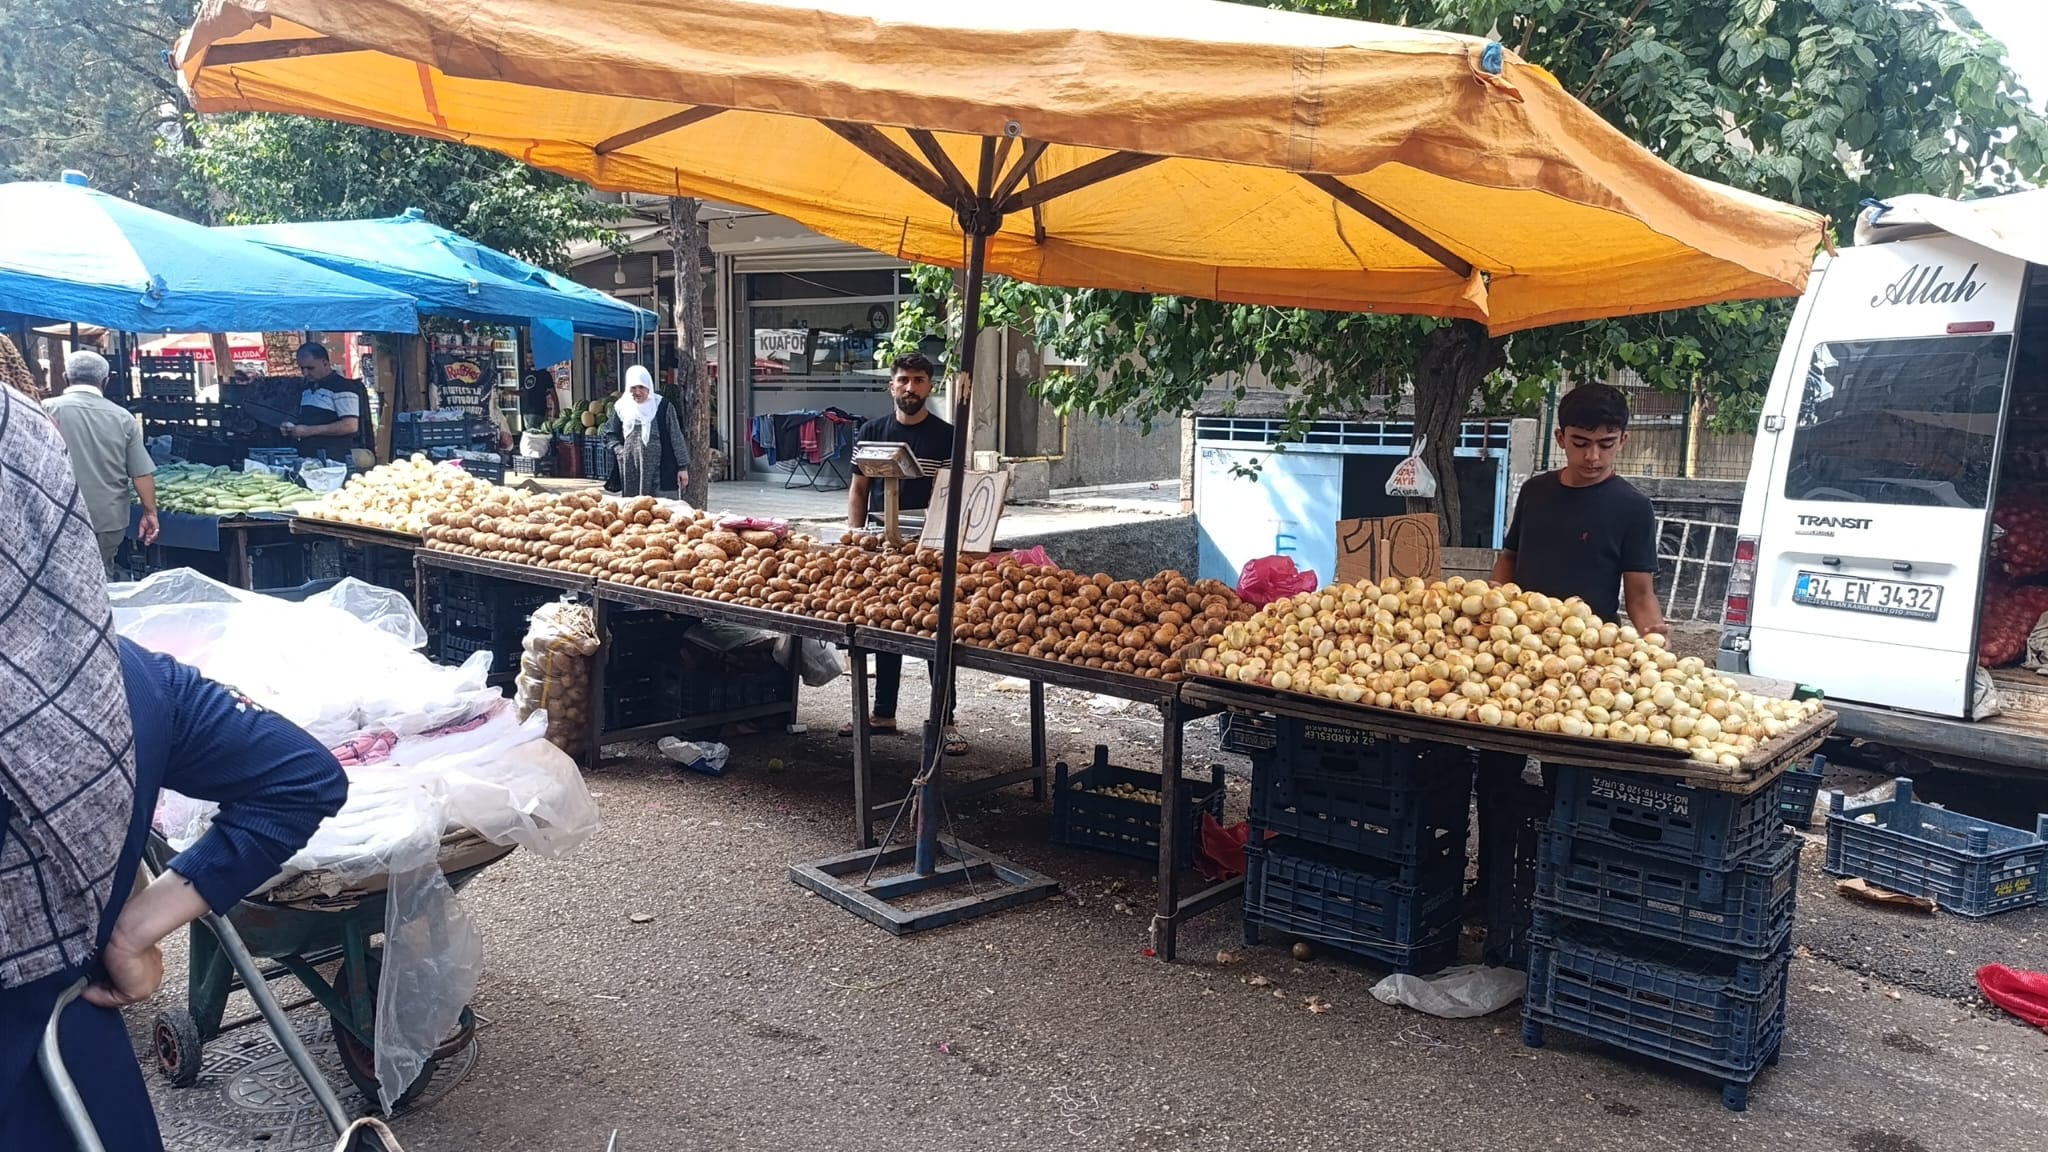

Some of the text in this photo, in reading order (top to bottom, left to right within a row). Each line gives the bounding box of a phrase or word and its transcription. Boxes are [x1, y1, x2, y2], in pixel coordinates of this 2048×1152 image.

[1870, 262, 1987, 308] Allah
[233, 350, 260, 359] ALGIDA
[1797, 514, 1873, 530] TRANSIT
[1343, 518, 1434, 587] 10
[1807, 577, 1934, 611] 34 EN 3432
